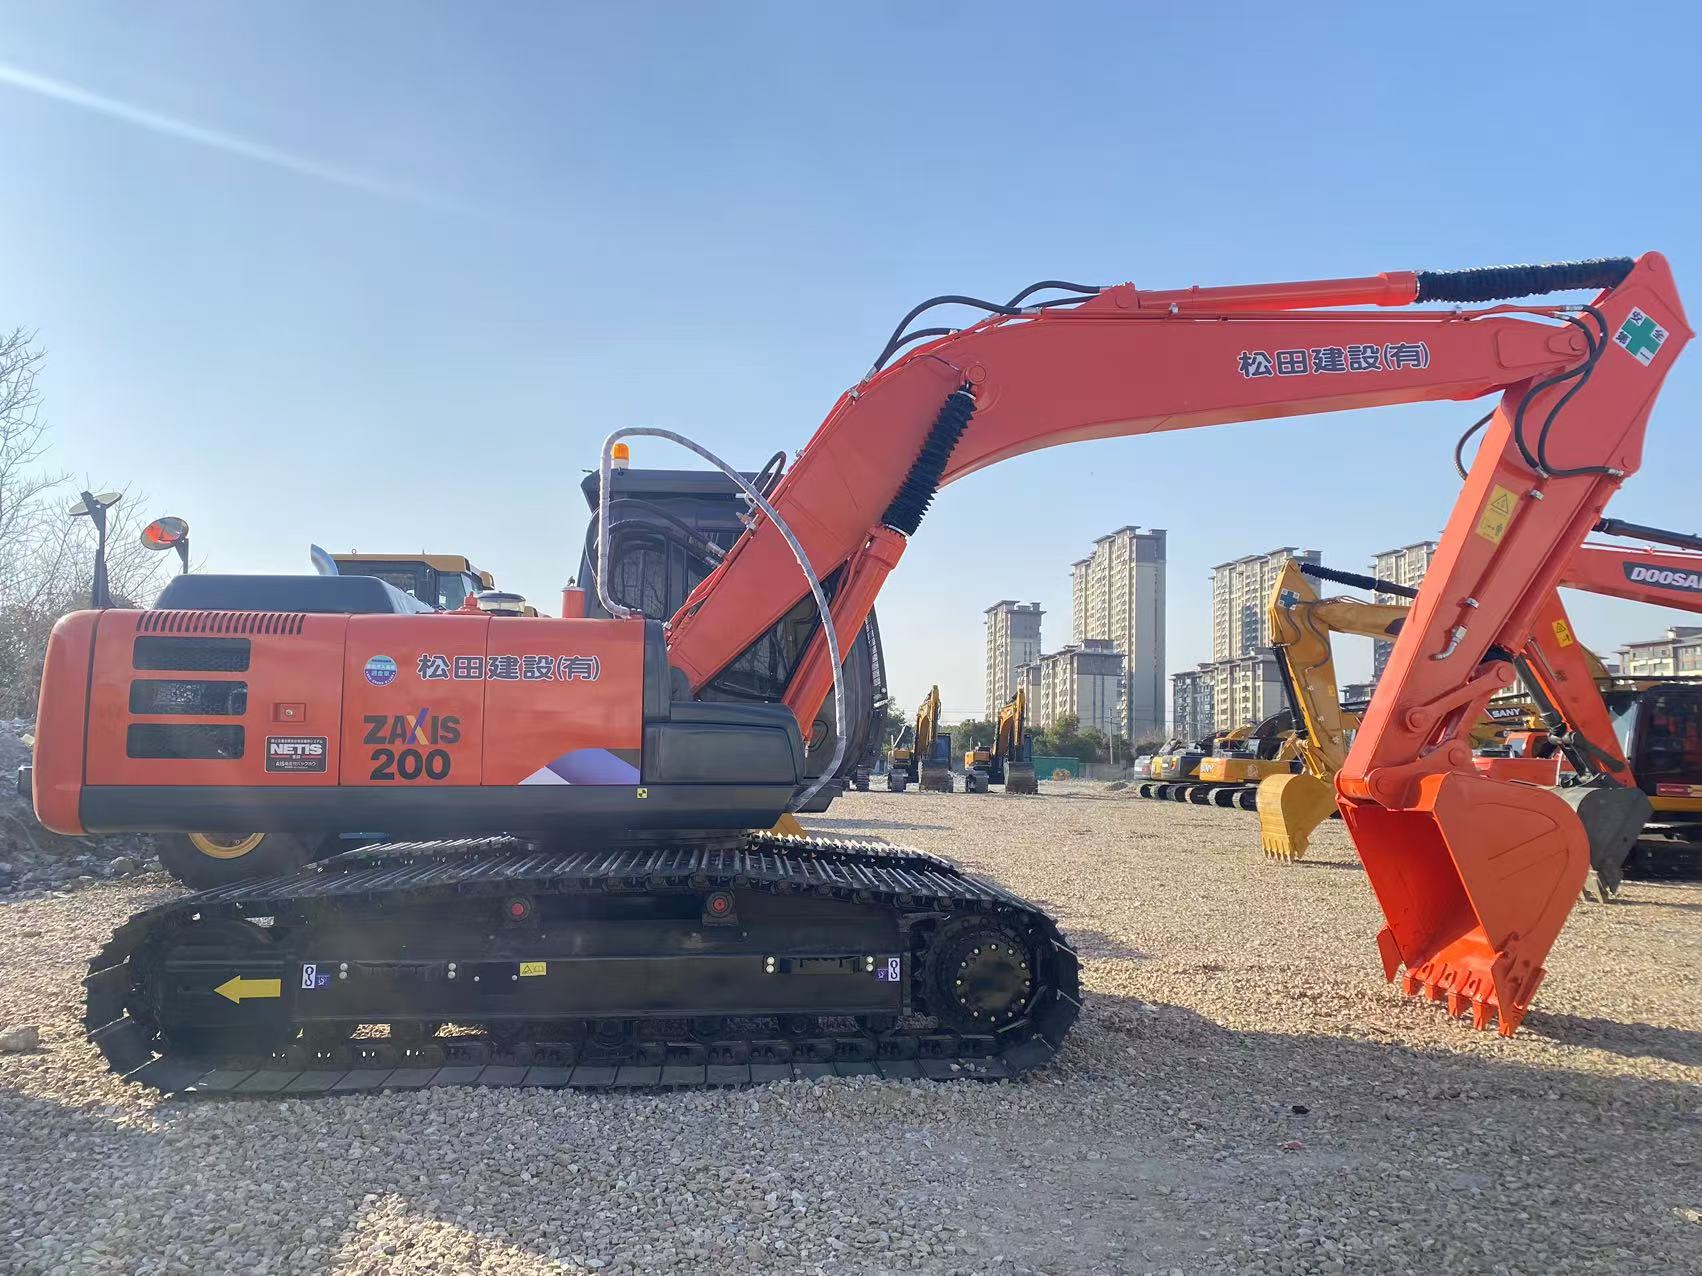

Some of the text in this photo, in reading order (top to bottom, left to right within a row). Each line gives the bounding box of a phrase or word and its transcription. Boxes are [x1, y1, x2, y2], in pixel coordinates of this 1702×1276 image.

[1237, 342, 1430, 379] 松田建設(有)
[1630, 567, 1702, 589] DOOSA
[417, 653, 601, 681] 松田建設(有)
[363, 707, 461, 745] ZAXIS
[1492, 708, 1520, 718] SANY
[270, 743, 323, 755] NETIS
[370, 748, 451, 780] 200
